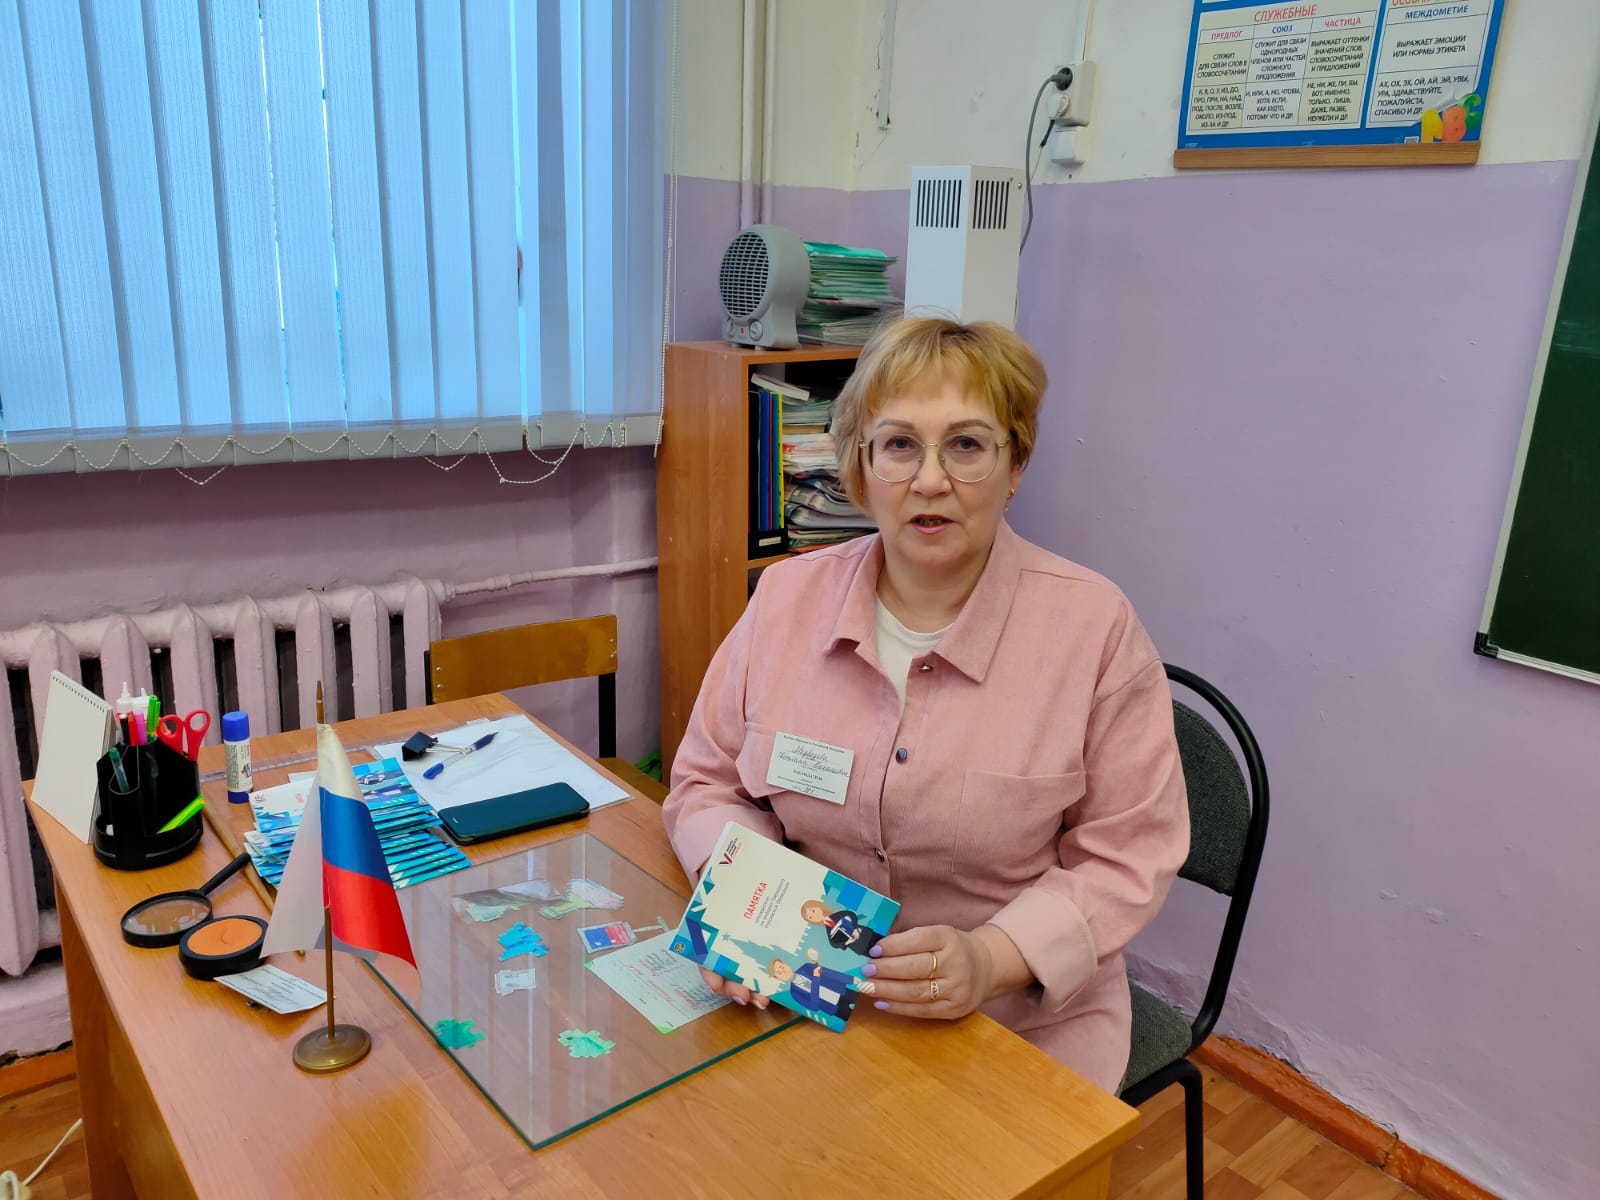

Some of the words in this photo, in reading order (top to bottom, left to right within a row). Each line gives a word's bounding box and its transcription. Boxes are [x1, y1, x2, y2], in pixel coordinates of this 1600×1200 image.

[1254, 4, 1317, 22] СЛУЖЕБНЫЕ
[1405, 5, 1469, 19] МЕЖДОМЕТИЕ
[1324, 17, 1361, 28] ЧАСТИЦА
[1272, 25, 1293, 34] СОЮЗ
[1211, 31, 1243, 41] ПРЕДЛОГ
[1311, 38, 1342, 47] ВЫРАЖАЕТ
[1342, 35, 1370, 44] ОТТЕНКИ
[1277, 39, 1288, 47] ДЛЯ
[1289, 37, 1307, 45] СВЯЗИ
[1396, 38, 1433, 48] ВЫРАЖАЕТ
[1433, 35, 1467, 45] ЭМОЦИИ
[1260, 47, 1298, 56] ОДНОРОДНЫХ
[1314, 46, 1345, 55] ЗНАЧЕНИЙ
[1392, 50, 1408, 58] ИЛИ
[1408, 48, 1435, 57] НОРМЫ
[1435, 45, 1466, 54] ЭТИКЕТА
[1284, 54, 1306, 62] ЧАСТЕЙ
[1309, 53, 1364, 64] СЛОВОСОЧЕТАНИЙ
[1261, 64, 1292, 72] СЛОЖНОГО
[1316, 62, 1361, 72] ПРЕДЛОЖЕНИЙ
[1255, 72, 1296, 81] ПРЕДЛОЖЕНИЯ
[1402, 79, 1412, 87] ЭХ,
[1414, 78, 1426, 86] ОЙ,
[1427, 77, 1438, 85] АЙ,
[1377, 90, 1391, 98] УРА,
[1377, 97, 1425, 107] ПОЖАЛУЙСТА,
[1374, 108, 1405, 116] СПАСИБО
[1307, 114, 1334, 122] НЕУЖЕЛИ
[743, 881, 768, 919] ПАМЯТКА
